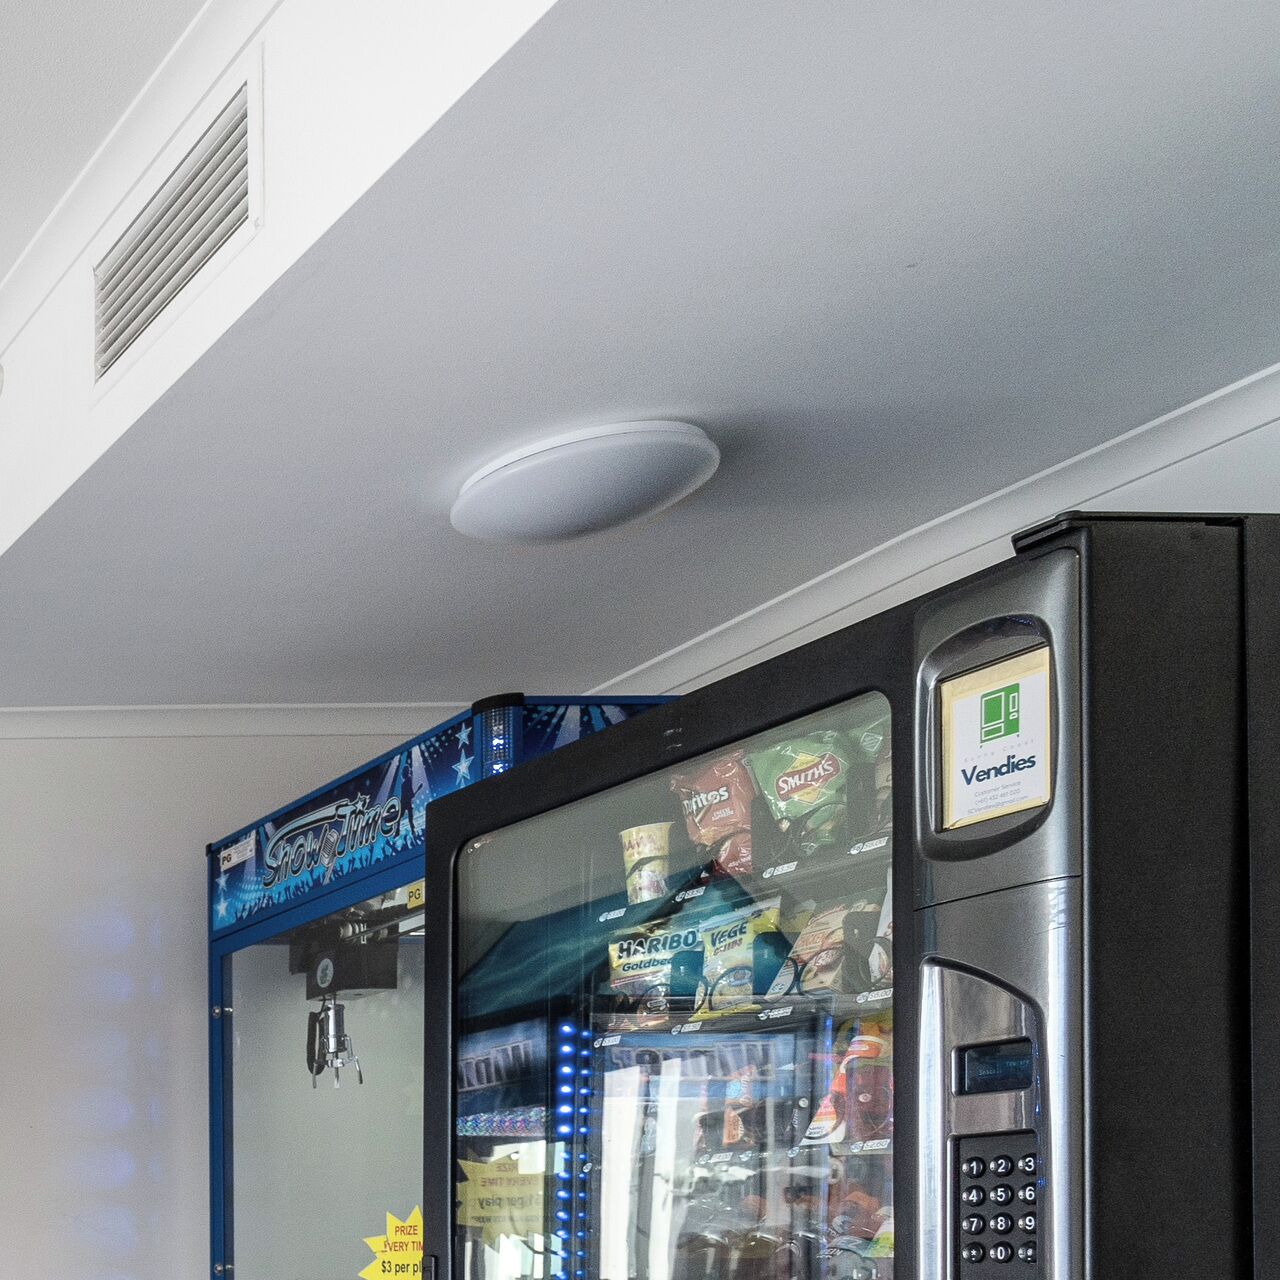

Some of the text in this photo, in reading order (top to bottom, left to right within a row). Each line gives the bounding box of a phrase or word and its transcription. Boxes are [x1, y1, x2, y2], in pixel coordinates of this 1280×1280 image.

[961, 754, 1036, 786] Vendies
[222, 853, 232, 866] PG
[409, 888, 422, 902] PG
[710, 922, 748, 948] VEGE
[617, 930, 698, 959] HARIBO
[970, 1157, 1035, 1174] 1 2 3
[968, 1186, 1035, 1202] 4 5 6
[394, 1225, 419, 1236] PRIZE
[970, 1216, 1035, 1231] 7 8 9
[996, 1246, 1006, 1260] 0
[381, 1261, 392, 1273] $3
[394, 1263, 411, 1276] per
